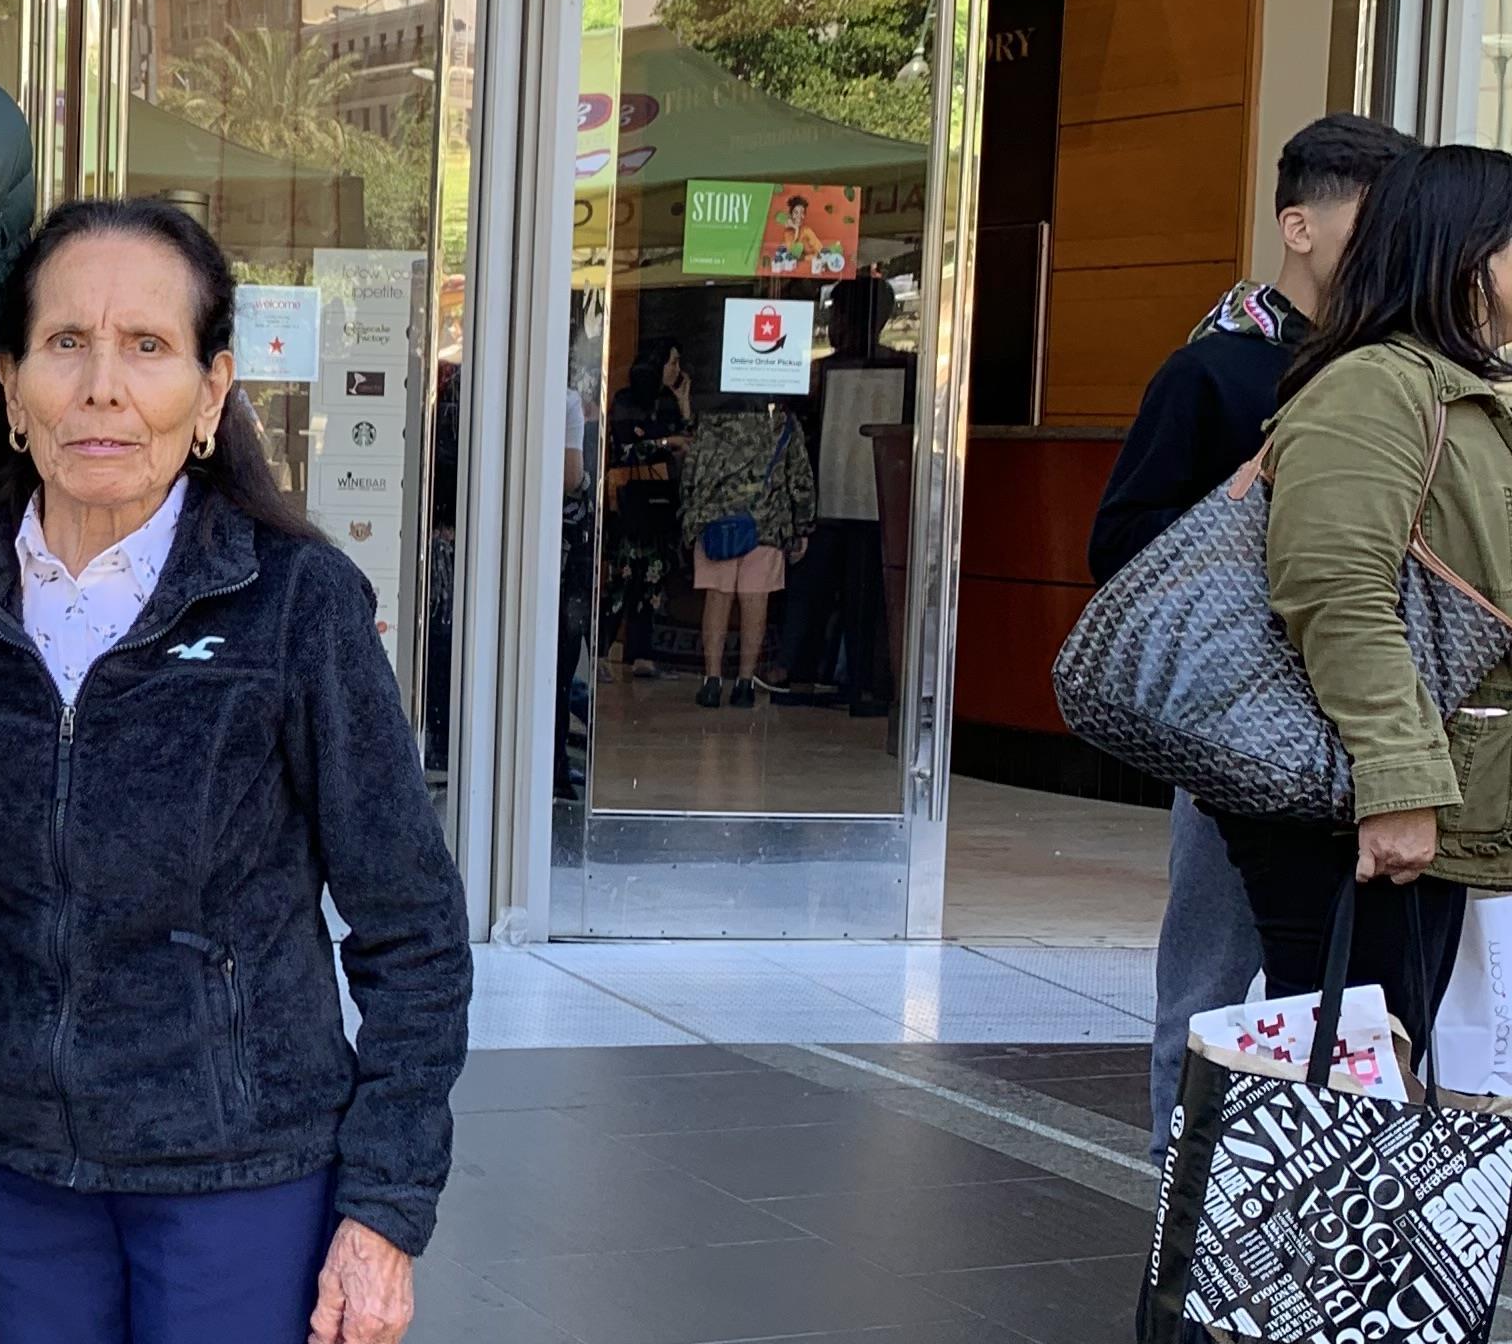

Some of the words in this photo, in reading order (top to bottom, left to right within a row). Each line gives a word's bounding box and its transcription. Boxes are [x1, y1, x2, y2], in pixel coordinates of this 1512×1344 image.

[692, 191, 752, 224] STORY
[730, 356, 754, 365] Online
[755, 357, 776, 366] Order
[777, 359, 803, 367] Pickup
[337, 472, 387, 489] WINEBAR
[1222, 1083, 1352, 1184] SEE
[1261, 1097, 1403, 1202] CURIOSIT
[1389, 1120, 1451, 1177] HOPE
[1217, 1159, 1253, 1204] ARE
[1348, 1143, 1405, 1211] DO
[1403, 1174, 1421, 1190] is
[1420, 1153, 1445, 1179] not
[1440, 1145, 1453, 1158] a
[1414, 1150, 1467, 1202] strategy
[1149, 1145, 1179, 1287] lululemon
[1204, 1177, 1246, 1240] RTANT.
[1406, 1206, 1421, 1223] bar
[1324, 1165, 1413, 1286] YOGA
[1416, 1218, 1439, 1247] search
[1421, 1196, 1484, 1269] GOALS
[1298, 1185, 1386, 1308] YOGA
[1412, 1235, 1438, 1267] answers
[1201, 1255, 1239, 1303] makes
[1220, 1253, 1252, 1296] leader
[1275, 1271, 1293, 1287] ON
[1433, 1262, 1461, 1298] important
[1444, 1255, 1464, 1279] found
[1248, 1280, 1279, 1305] HOLD
[1266, 1286, 1290, 1306] NOT
[1268, 1288, 1306, 1317] WORLD
[1288, 1297, 1312, 1317] THE
[1305, 1263, 1364, 1328] BE
[1455, 1294, 1472, 1313] most
[1263, 1310, 1292, 1333] REAL
[1266, 1322, 1292, 1343] PHO
[1288, 1305, 1318, 1329] YOUR
[1302, 1313, 1325, 1332] PUT
[1464, 1309, 1479, 1324] The
